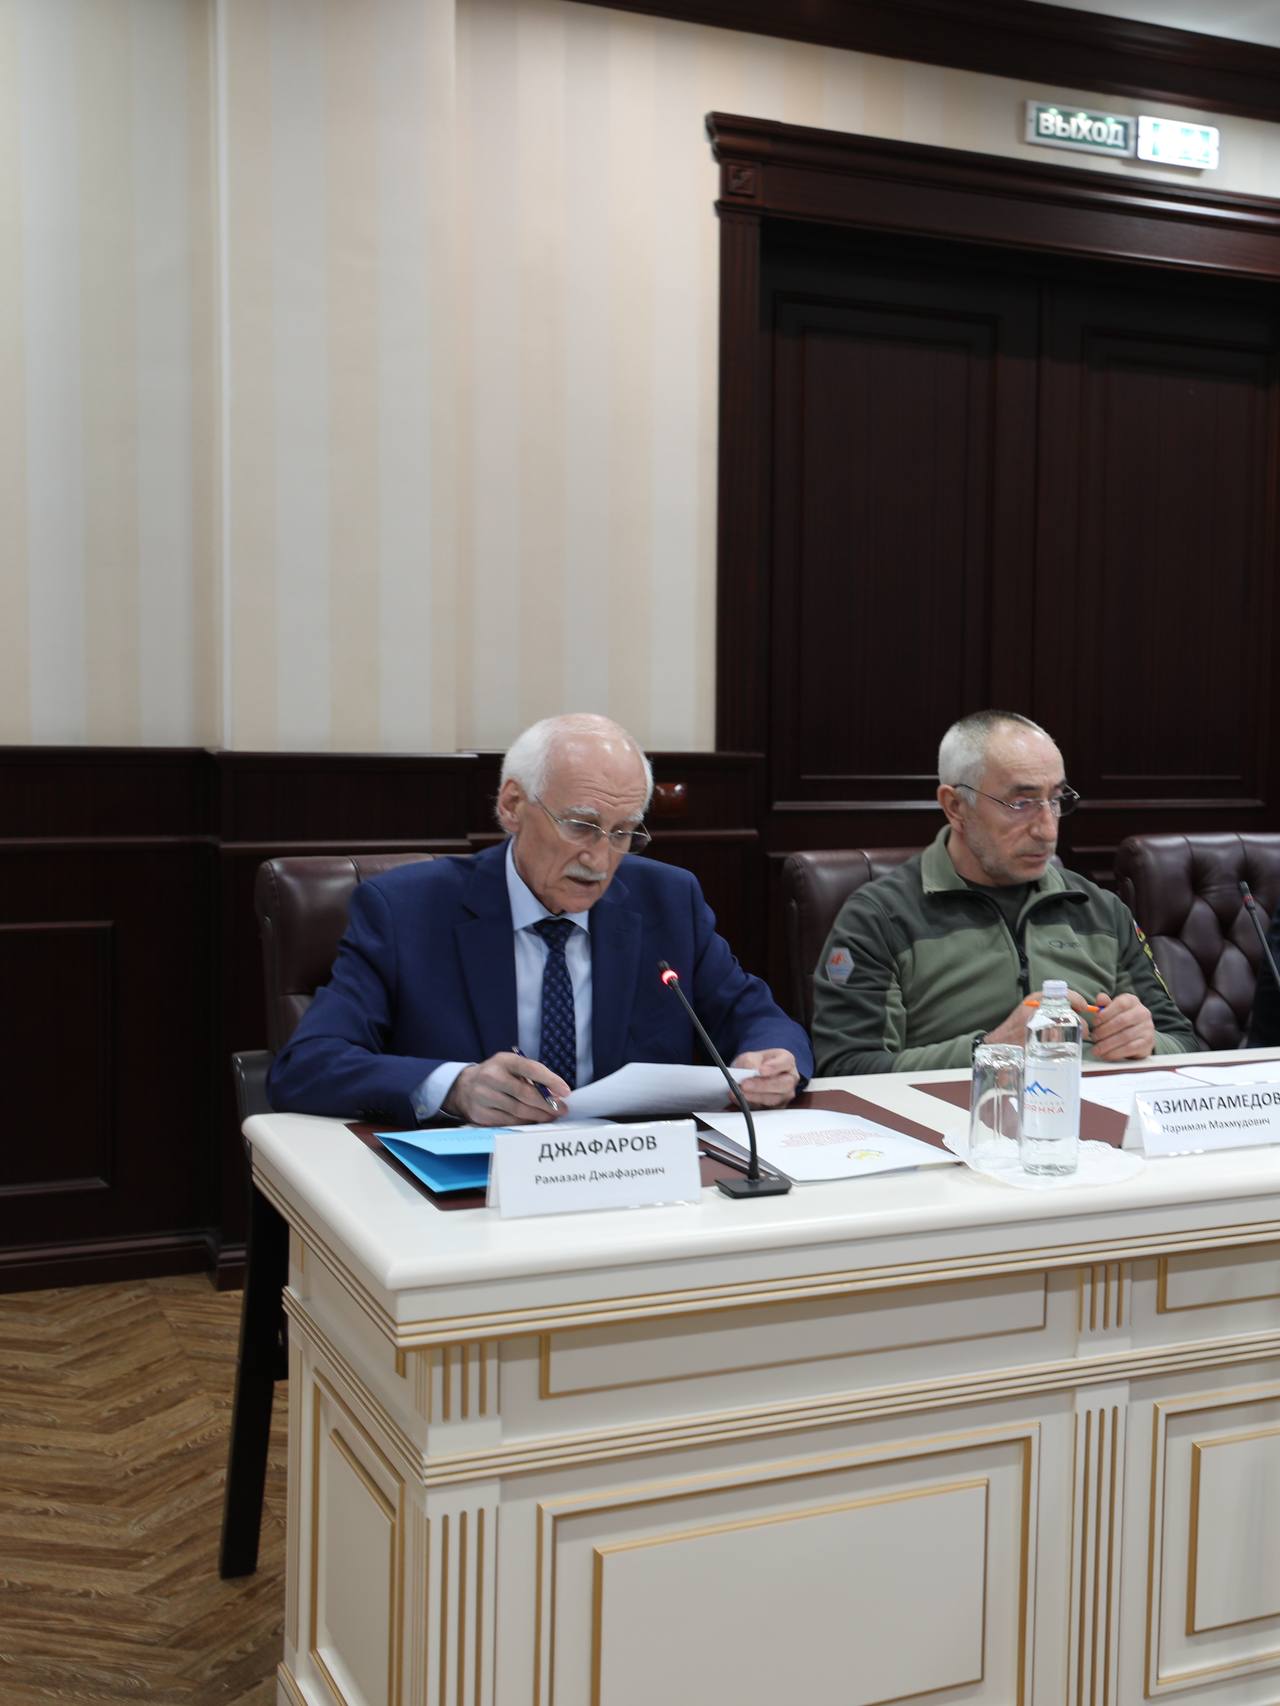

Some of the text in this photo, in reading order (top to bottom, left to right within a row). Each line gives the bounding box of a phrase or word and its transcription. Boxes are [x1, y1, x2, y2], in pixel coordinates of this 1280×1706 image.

[1038, 111, 1125, 148] ВЫХОД
[1162, 1116, 1271, 1135] Нариман Махмудович
[538, 1135, 658, 1163] ДЖАФАРОВ
[534, 1166, 666, 1185] Рамазан Джафарович
